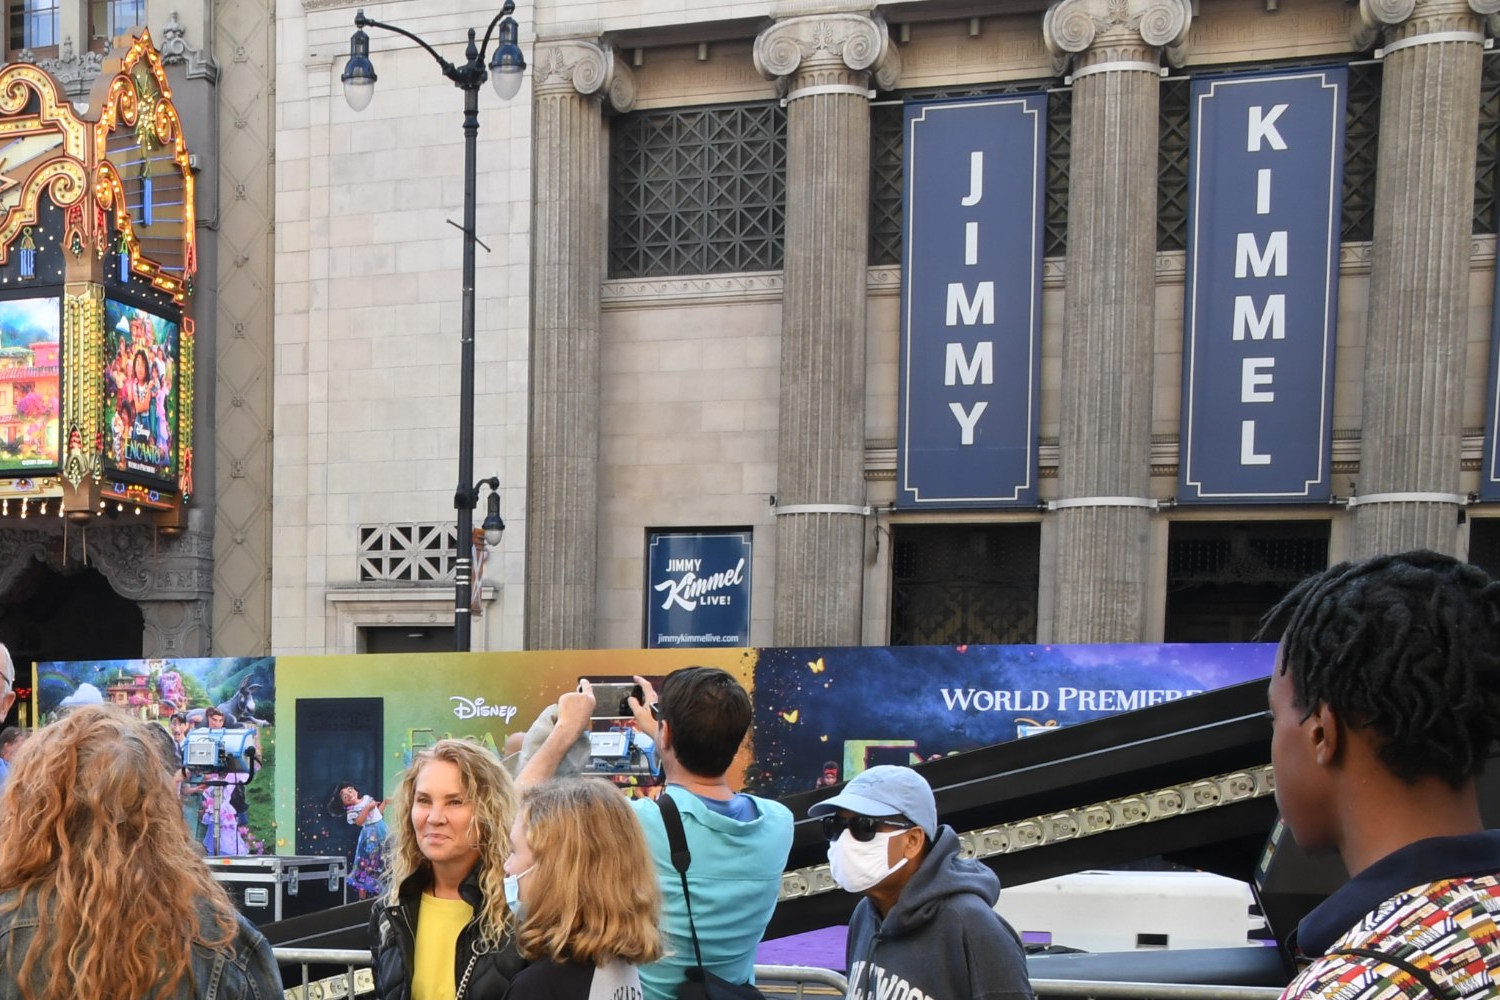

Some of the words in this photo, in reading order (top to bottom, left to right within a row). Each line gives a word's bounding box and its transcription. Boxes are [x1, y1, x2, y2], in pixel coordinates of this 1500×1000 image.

[1232, 104, 1289, 465] KIMMEL
[945, 151, 994, 445] JIMMY
[666, 559, 702, 572] JIMMY
[654, 557, 745, 611] Kimmel
[700, 596, 731, 606] LIVE!
[657, 633, 739, 644] jimmykimmellive.com
[940, 688, 1050, 712] WORLD
